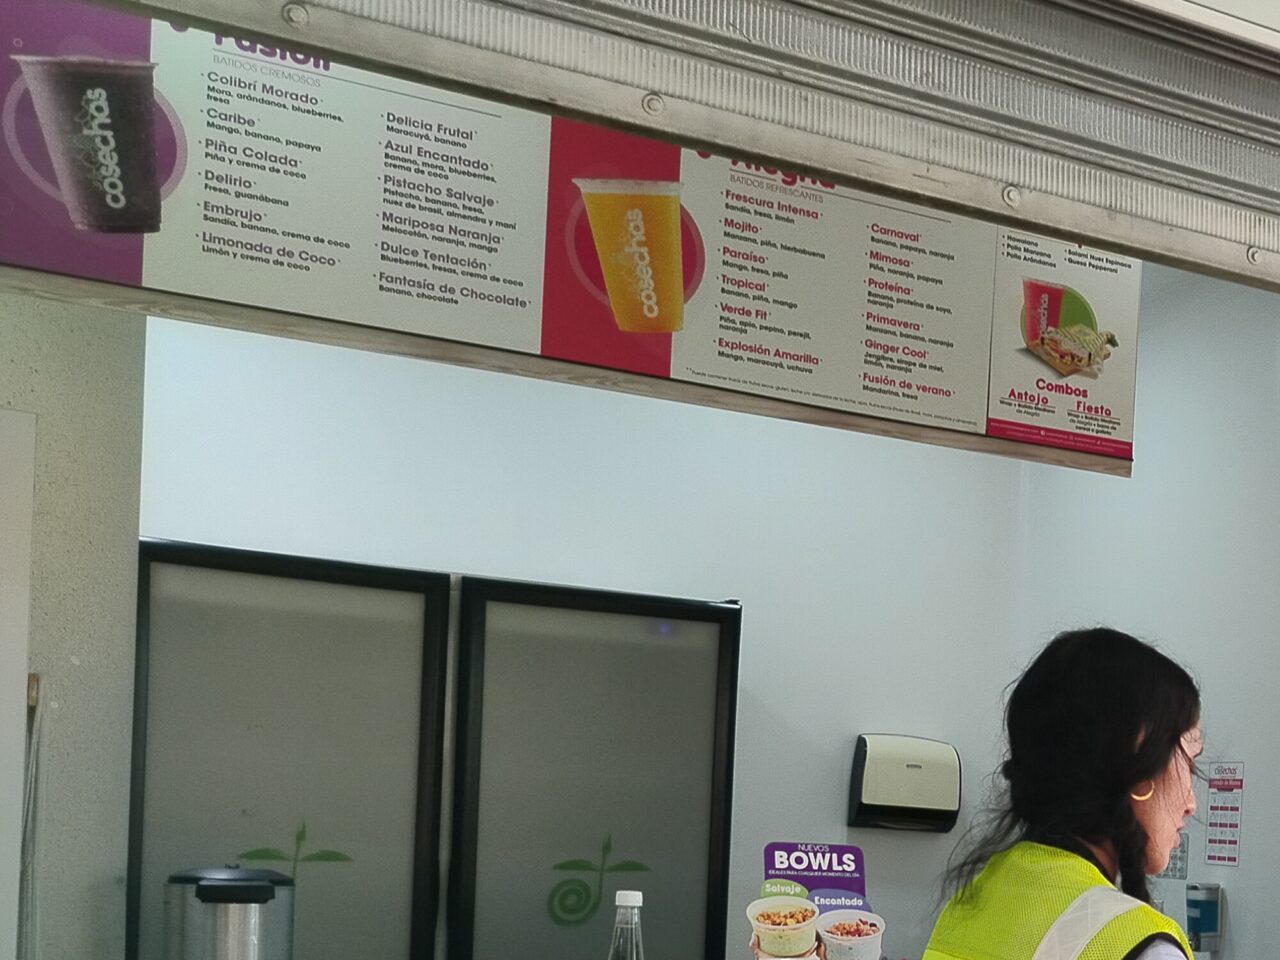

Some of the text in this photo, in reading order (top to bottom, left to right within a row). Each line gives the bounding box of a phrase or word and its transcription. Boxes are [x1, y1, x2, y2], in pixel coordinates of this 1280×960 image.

[213, 55, 321, 88] BATIDOS CREMOSOS
[207, 72, 318, 105] Colibrí Morado
[207, 108, 255, 127] Caribe
[387, 112, 473, 140] Delicia Frutal
[84, 88, 126, 208] cosechas
[205, 138, 298, 168] Piña Colada
[385, 140, 489, 171] Azul Encantado
[205, 170, 252, 189] Delirio
[730, 174, 823, 204] BATIDOS REFRESCANTES
[384, 174, 494, 207] Pistacho Salvaje
[204, 200, 262, 222] Embrujo
[726, 189, 818, 219] Frescura Intensa
[382, 211, 500, 244] Mariposa Naranja
[724, 217, 758, 234] Mojito
[871, 223, 919, 242] Carnaval
[202, 231, 336, 266] Limonada de Coco
[381, 241, 486, 271] Dulce Tentación
[723, 246, 765, 264] Paraíso
[869, 250, 910, 267] Mimosa
[625, 209, 658, 318] cosechas
[379, 272, 527, 308] Fantasía de Chocolate
[721, 274, 765, 292] Tropical
[868, 278, 910, 295] Proteína
[720, 302, 767, 320] Verde Fit
[866, 312, 920, 331] Primavera
[718, 337, 819, 365] Explosión Amarilla
[865, 339, 926, 359] Ginger Cool
[863, 372, 951, 397] Fusión de verano
[1036, 378, 1088, 398] Combos
[1008, 388, 1048, 406] Antojo
[1076, 401, 1112, 416] Fiesta
[774, 851, 856, 872] BOWLS
[765, 884, 801, 895] Salvaje
[814, 896, 863, 906] Encantado
